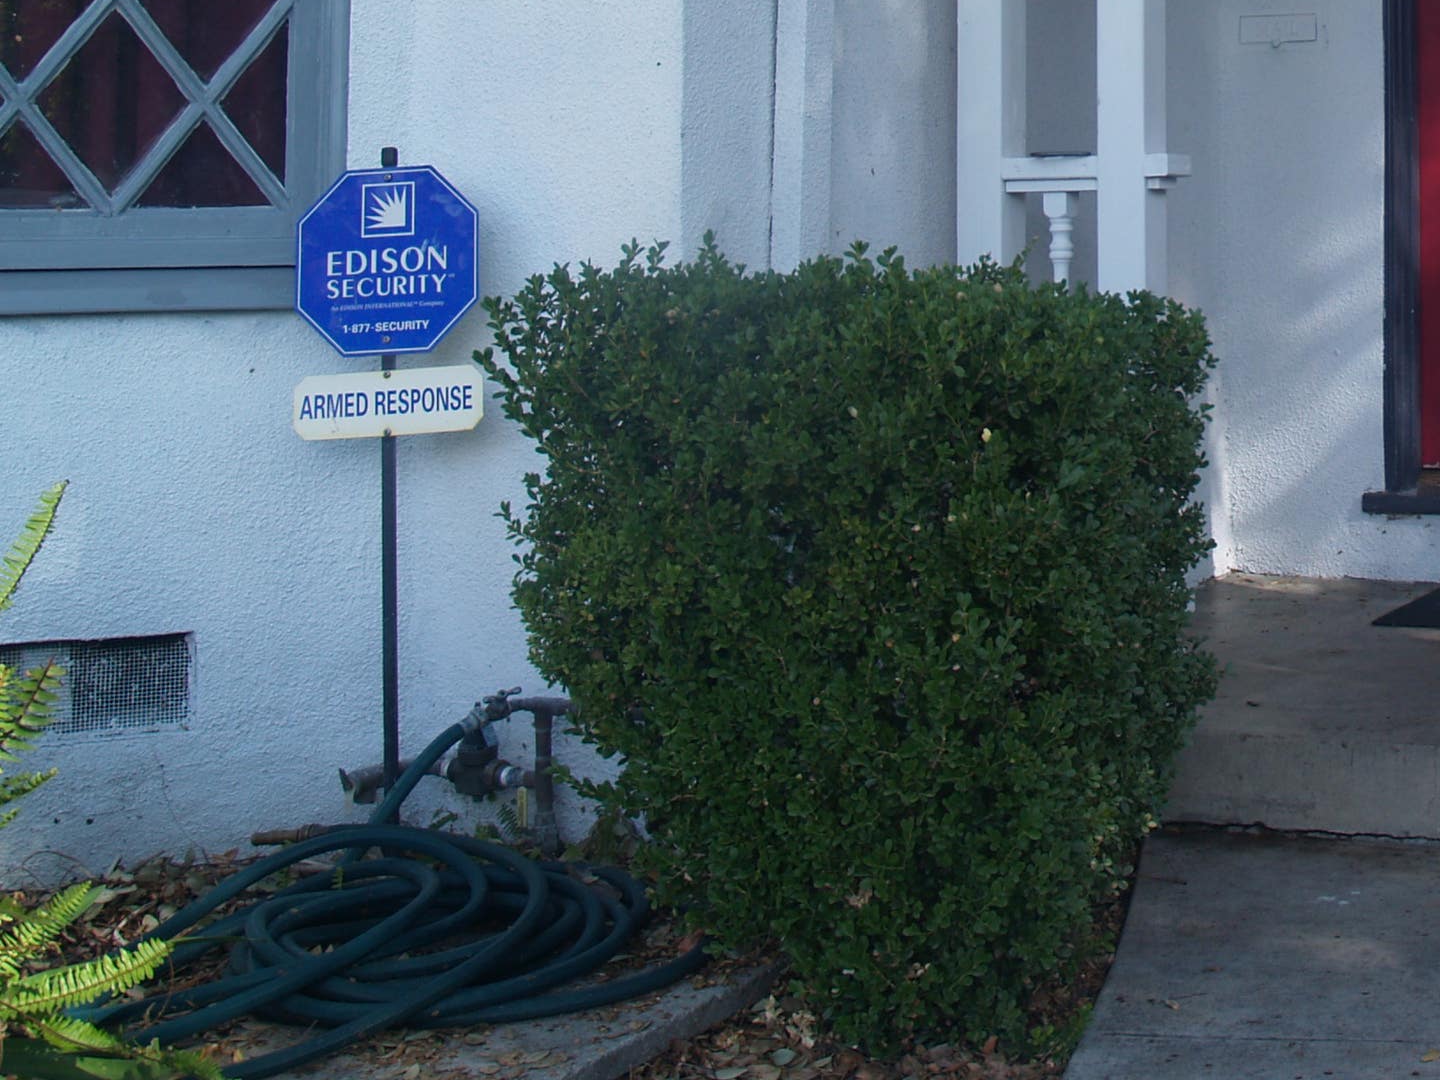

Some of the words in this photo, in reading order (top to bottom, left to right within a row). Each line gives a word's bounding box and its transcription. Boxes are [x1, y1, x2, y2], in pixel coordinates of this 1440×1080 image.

[326, 245, 448, 277] EDISON
[326, 273, 447, 300] SECURITY
[343, 319, 430, 334] 1-877-SECURITY
[299, 391, 369, 420] ARMED
[374, 384, 473, 416] RESPONSE
